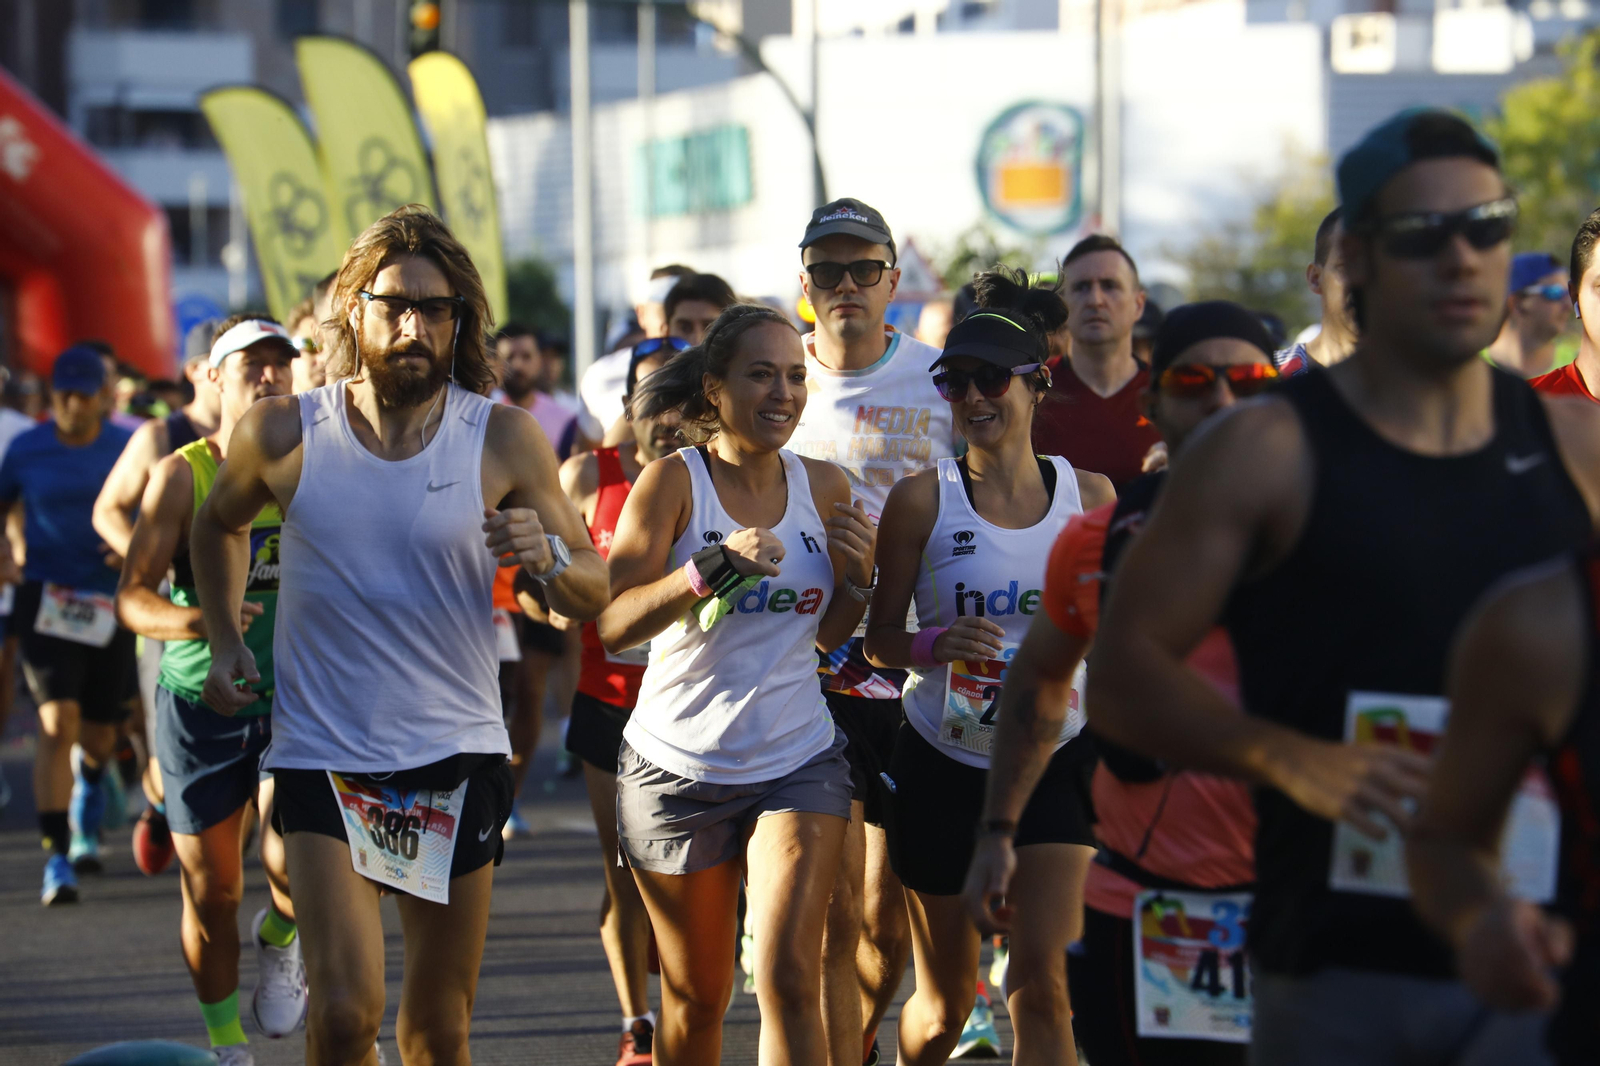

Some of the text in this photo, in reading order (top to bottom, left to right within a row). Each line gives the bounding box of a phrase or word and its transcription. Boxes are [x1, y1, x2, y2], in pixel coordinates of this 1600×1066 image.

[819, 211, 868, 223] Heineken
[852, 405, 931, 436] MEDIA
[847, 435, 932, 462] MARATÓN
[864, 467, 895, 487] DEL
[800, 531, 822, 553] in
[728, 581, 824, 615] dea
[955, 580, 1044, 617] inde
[367, 806, 421, 861] 386
[1207, 900, 1251, 949] 3
